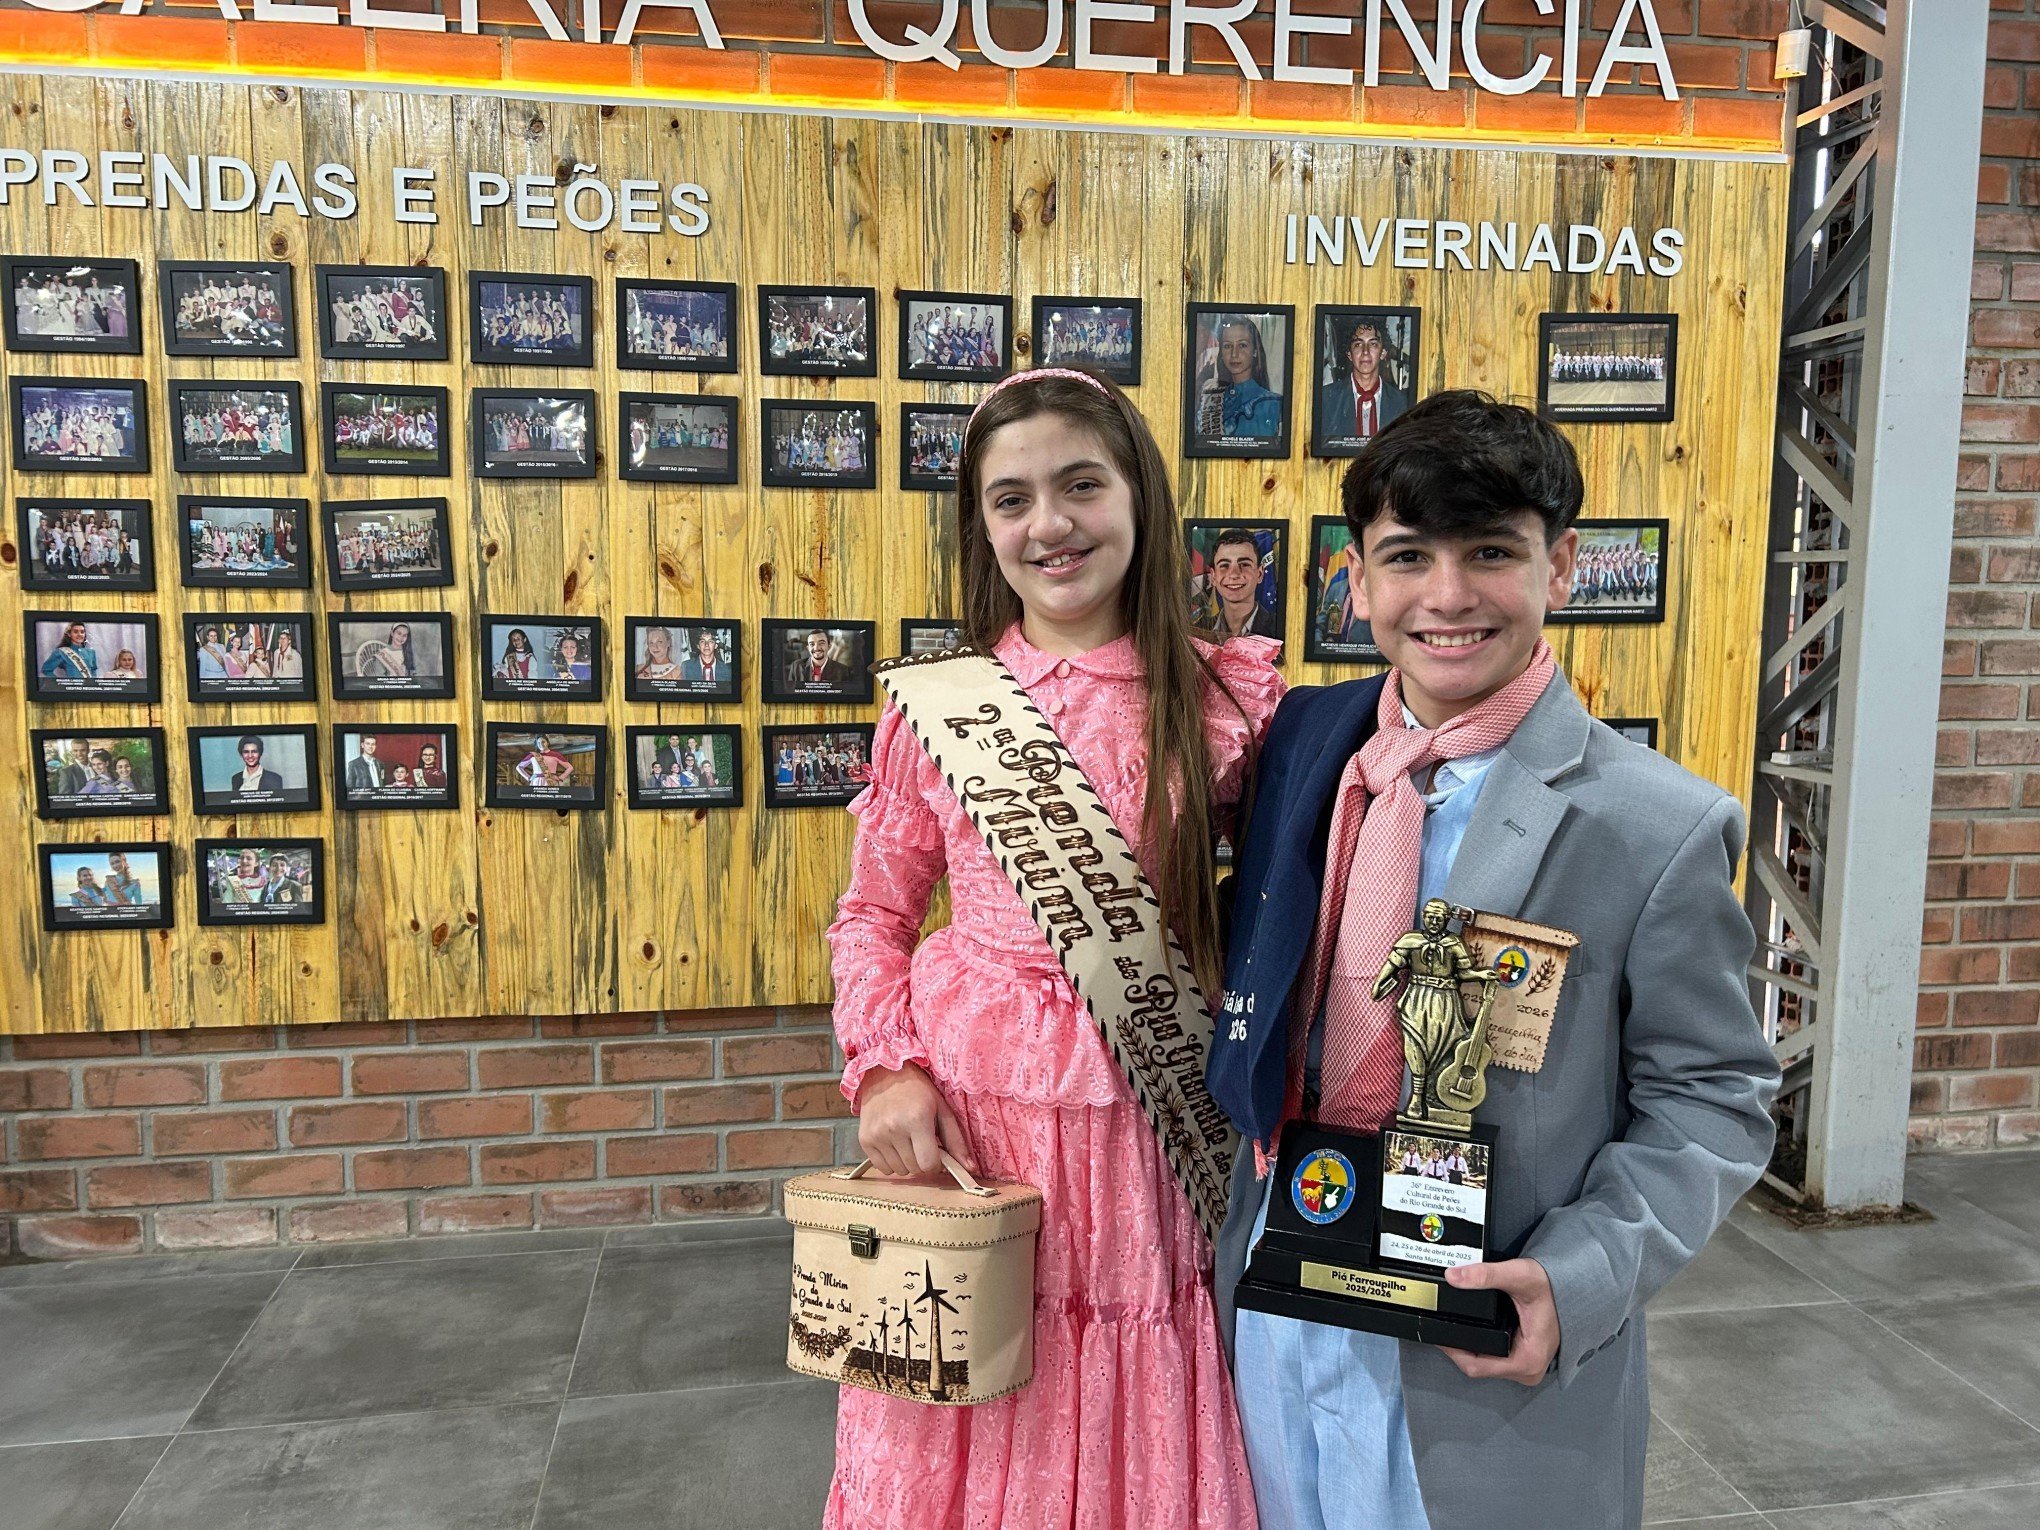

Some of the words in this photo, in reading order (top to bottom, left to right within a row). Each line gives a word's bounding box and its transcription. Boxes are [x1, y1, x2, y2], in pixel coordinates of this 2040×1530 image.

[0, 149, 357, 219] PRENDAS
[392, 167, 437, 223] E
[468, 163, 709, 236] PEÕES
[1286, 213, 1684, 277] INVERNADAS
[998, 739, 1144, 942] Prenda
[963, 775, 1093, 951] Mirim
[1113, 955, 1142, 981] do
[1124, 973, 1184, 1042] Rio
[1517, 1004, 1549, 1018] 2026
[1150, 1033, 1231, 1151] Grande
[1406, 1189, 1432, 1200] Cultural
[1442, 1195, 1460, 1204] Peões
[1424, 1184, 1455, 1194] Entrevero
[1409, 1198, 1420, 1206] Rio
[1421, 1202, 1444, 1210] Grande
[1405, 1253, 1423, 1261] Santa
[1424, 1256, 1443, 1264] Maria
[1414, 1244, 1422, 1252] 26
[1431, 1248, 1446, 1256] abril
[1446, 1250, 1455, 1258] de
[1455, 1252, 1472, 1260] 2025
[797, 1264, 816, 1283] Prenda
[819, 1271, 848, 1290] Mirim
[1331, 1270, 1347, 1281] Piá
[1350, 1274, 1406, 1291] Farroupilha
[799, 1288, 823, 1308] Grande
[826, 1298, 834, 1310] do
[837, 1298, 852, 1313] Sul
[811, 1284, 819, 1295] do
[1346, 1283, 1391, 1298] 2025/2026
